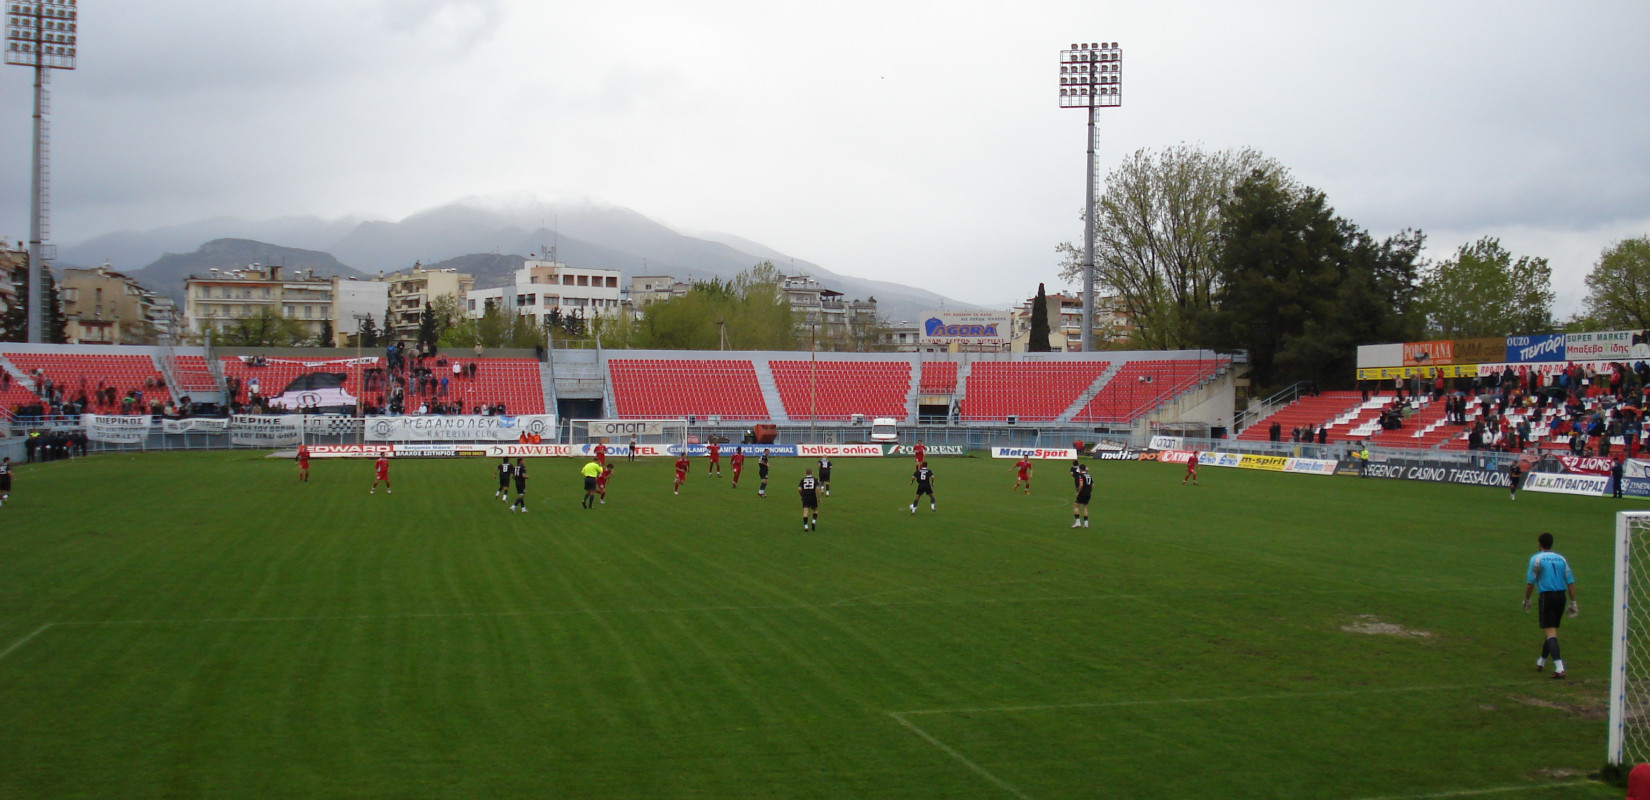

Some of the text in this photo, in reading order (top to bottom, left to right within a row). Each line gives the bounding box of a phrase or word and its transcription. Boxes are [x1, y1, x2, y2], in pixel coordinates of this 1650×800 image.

[934, 325, 996, 336] AGORA
[1597, 333, 1629, 341] MARKET
[1507, 339, 1529, 348] OUZO
[403, 418, 521, 428] ΜΕΛΑΝΟΛΕΥΚΙ
[802, 446, 879, 454] hellas online
[999, 448, 1068, 458] MetroSport
[1580, 458, 1611, 471] LIONS
[920, 471, 927, 480] 6
[1407, 468, 1446, 481] CASINO
[1448, 471, 1511, 486] THESSALONI
[803, 481, 815, 490] 23
